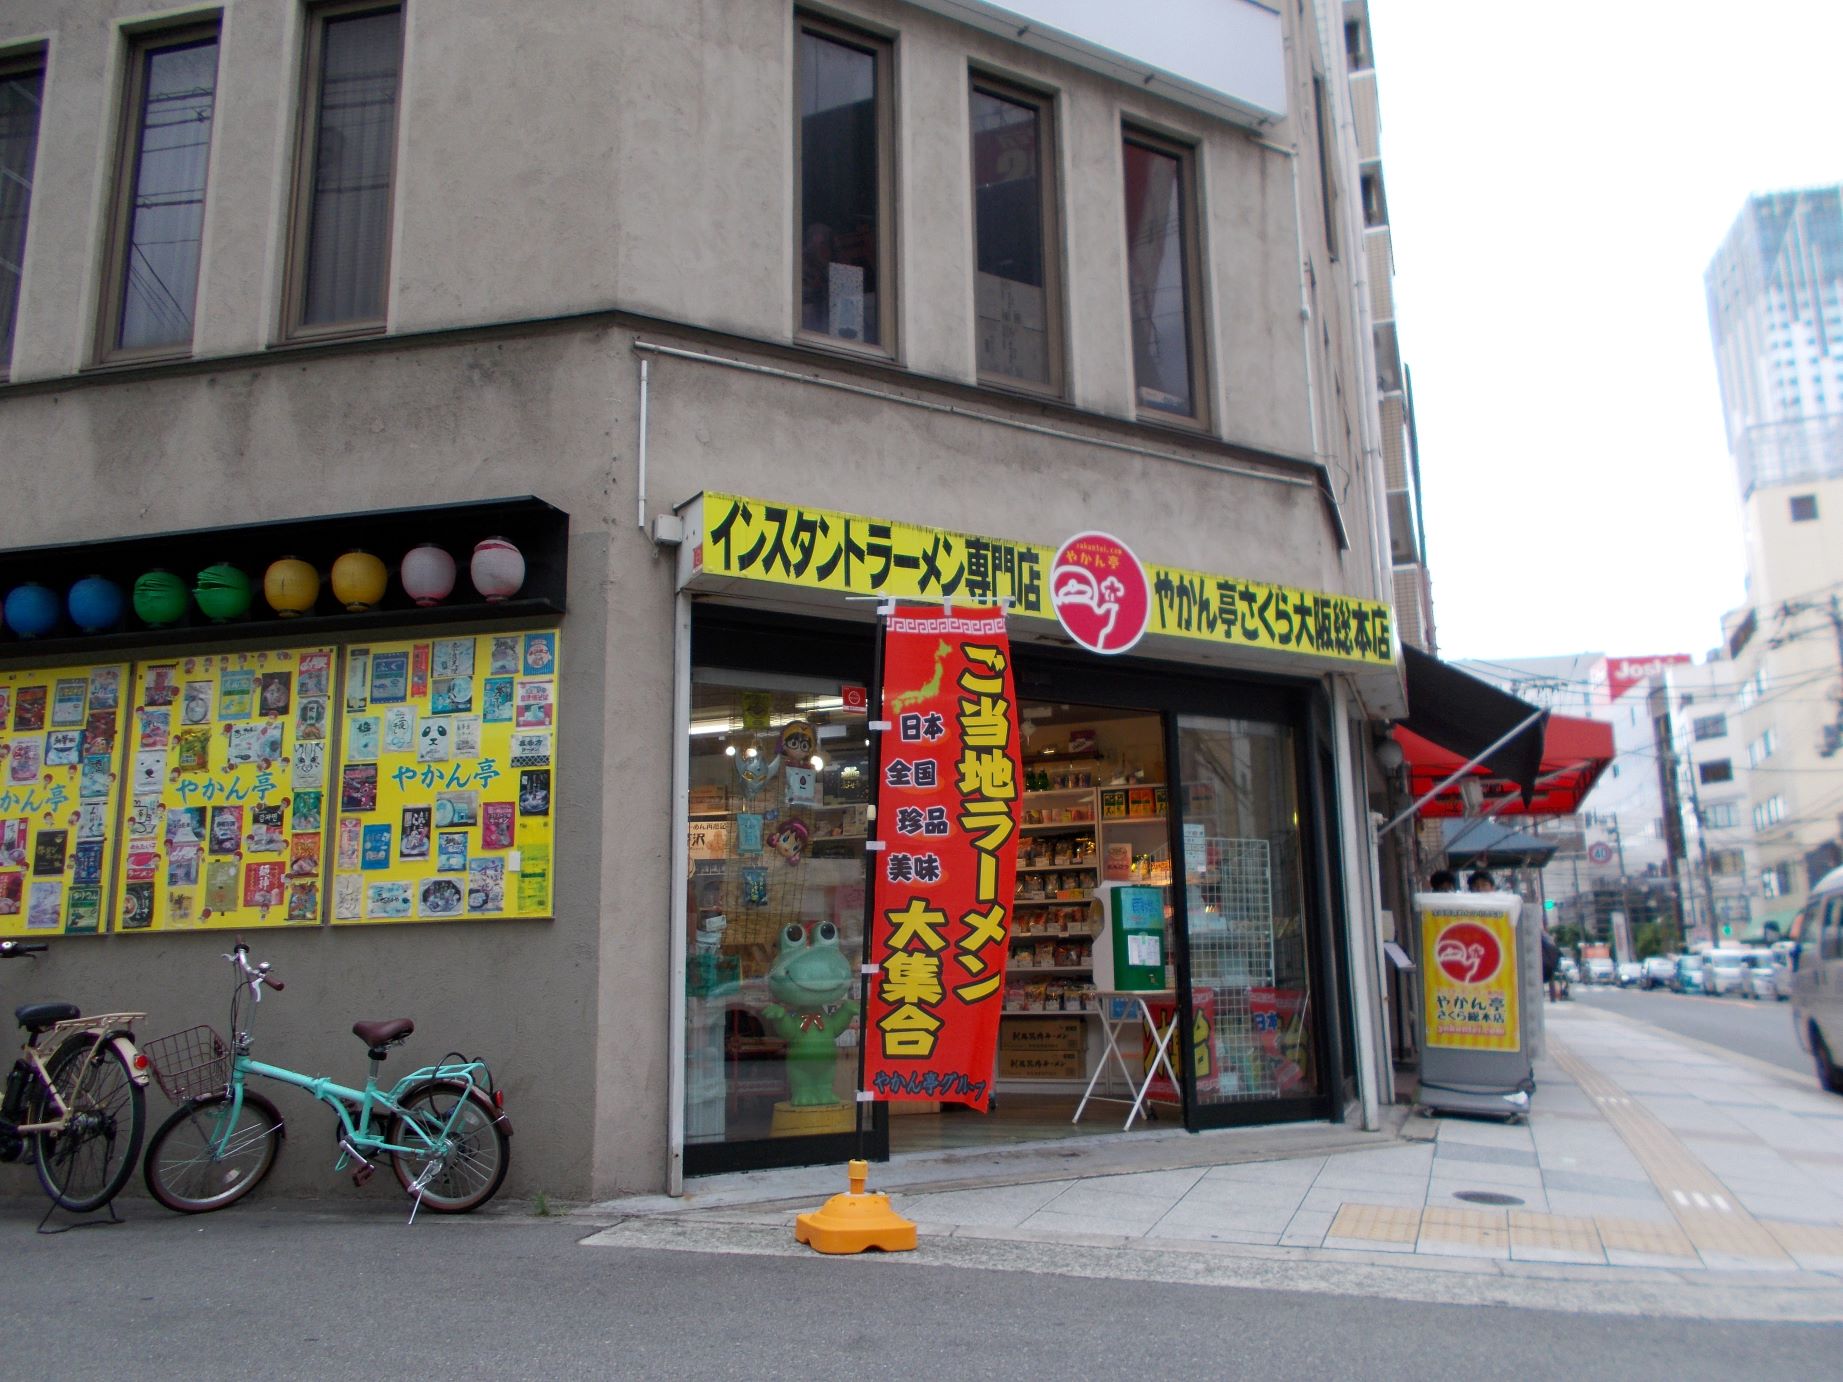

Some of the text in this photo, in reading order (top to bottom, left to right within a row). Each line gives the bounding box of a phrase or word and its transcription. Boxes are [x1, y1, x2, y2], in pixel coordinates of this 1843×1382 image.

[710, 499, 1041, 612] インスタントラーメン専門店
[1066, 549, 1120, 570] やかん亭
[1154, 570, 1392, 661] やかん亭さくら大阪総本店
[900, 712, 944, 742] 日本
[176, 771, 278, 804] やかん亭
[391, 757, 500, 793] やかん亭
[886, 758, 937, 787] 全国
[0, 784, 70, 814] かん亭
[897, 805, 950, 836] 珍品
[953, 641, 1017, 1005] ご当地ラーメン
[887, 853, 942, 882] 美味
[876, 895, 949, 1060] 大集合
[1437, 995, 1504, 1011] やかん亭
[1437, 1010, 1505, 1024] さくら総本店
